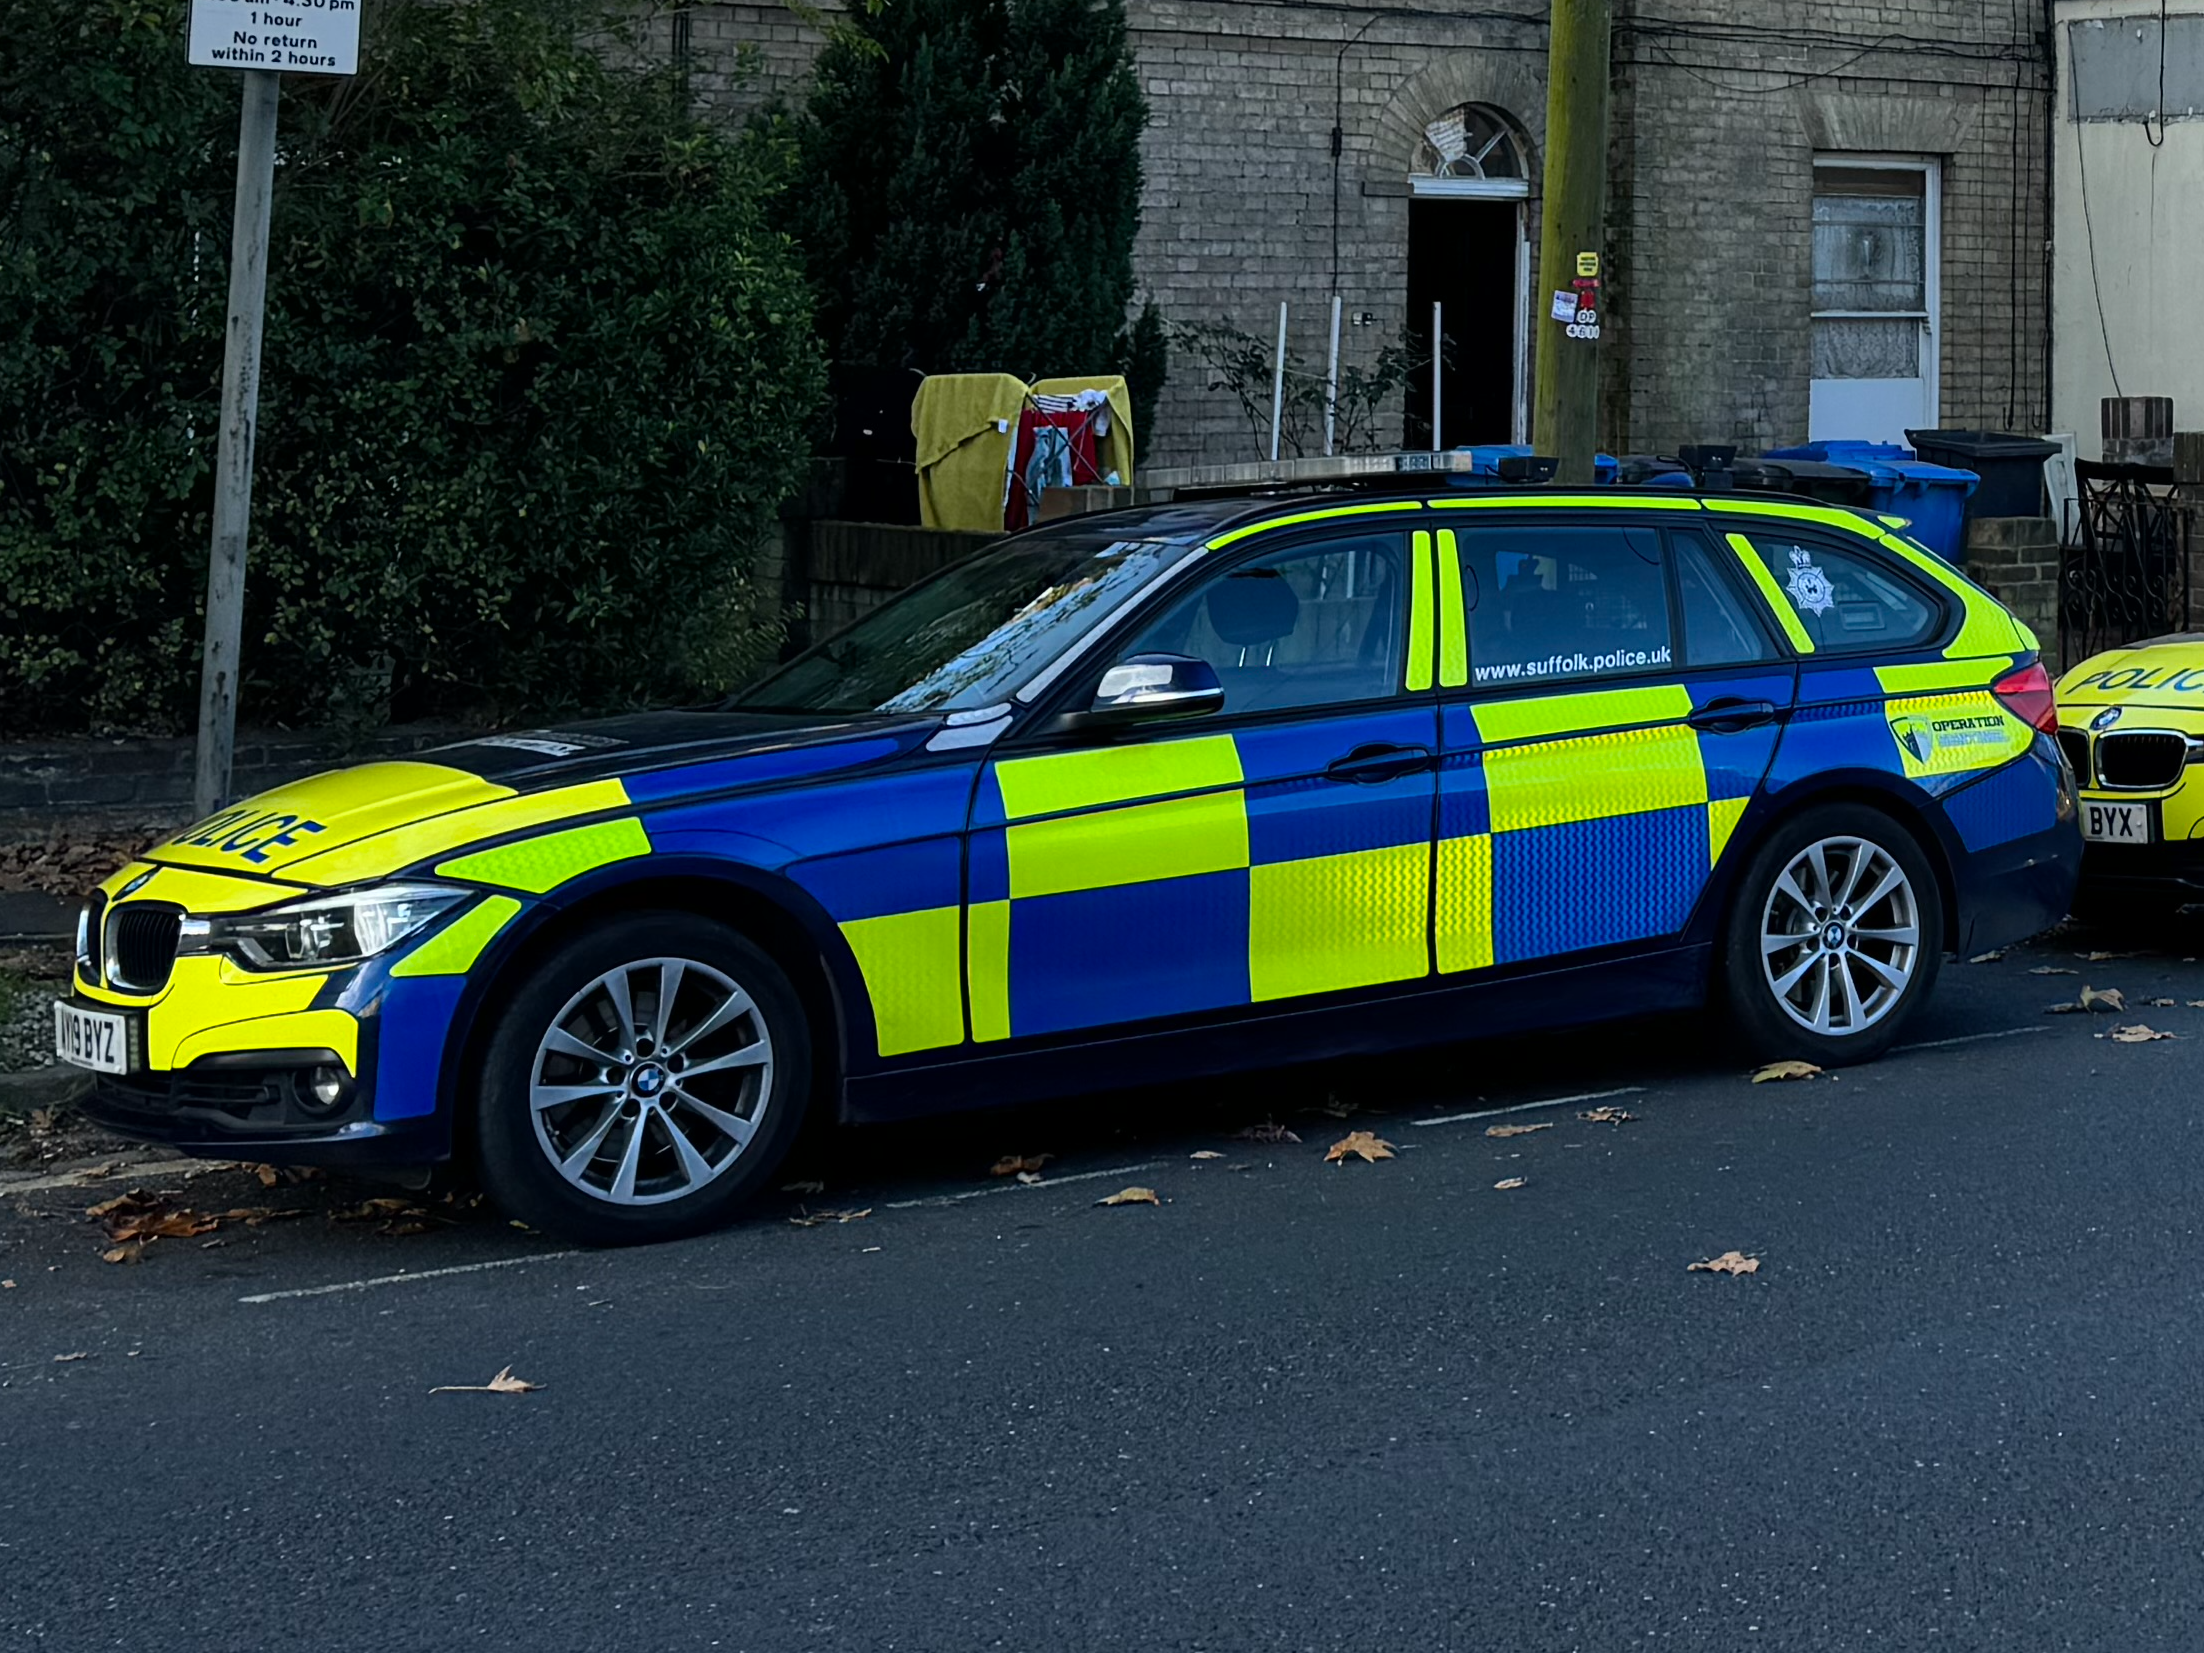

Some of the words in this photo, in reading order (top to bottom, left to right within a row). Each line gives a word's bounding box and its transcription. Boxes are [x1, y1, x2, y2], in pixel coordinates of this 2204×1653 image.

[329, 0, 355, 11] pm
[250, 11, 257, 24] 1
[263, 12, 303, 27] hour
[233, 31, 257, 45] No
[264, 34, 317, 49] return
[211, 47, 265, 62] within
[271, 50, 282, 63] 2
[288, 51, 336, 66] hours
[1475, 646, 1671, 681] www.suffolk.police.uk
[2065, 667, 2204, 694] POLIC
[1932, 715, 2005, 732] OPERATION
[2089, 806, 2133, 837] BYX
[171, 809, 328, 864] OLICE
[83, 1017, 115, 1064] BYZ
